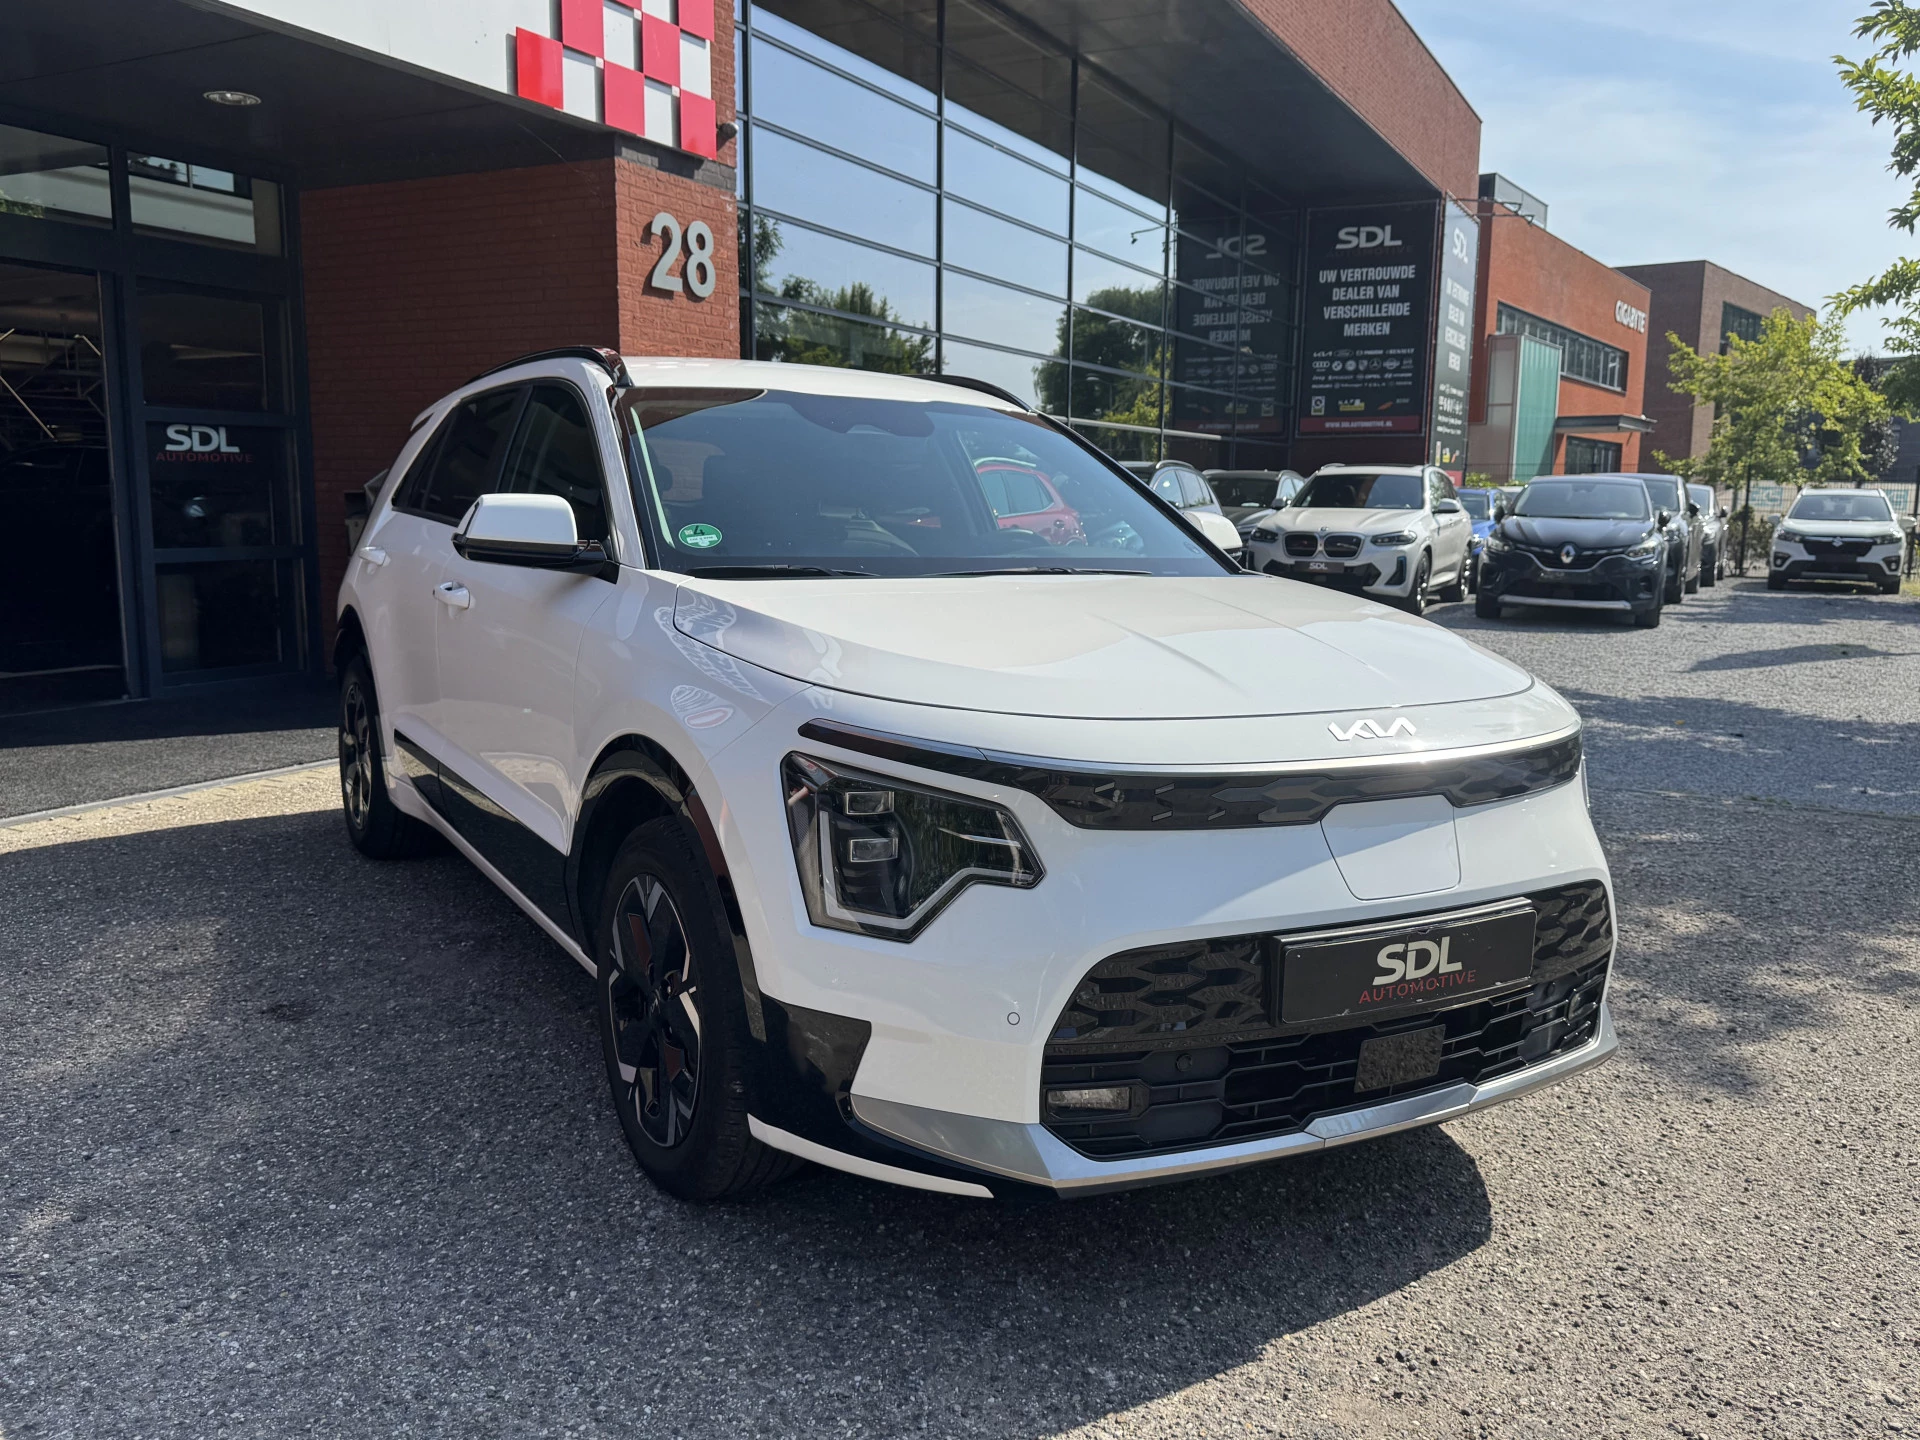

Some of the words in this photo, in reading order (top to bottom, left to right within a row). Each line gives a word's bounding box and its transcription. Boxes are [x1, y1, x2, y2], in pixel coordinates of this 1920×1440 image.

[1336, 225, 1402, 249] SDL
[651, 212, 716, 298] 28
[1319, 270, 1338, 283] UW
[1340, 265, 1416, 282] VERTROUWDE
[1332, 286, 1374, 301] DEALER
[1377, 285, 1400, 299] VAN
[1323, 302, 1411, 320] VERSCHILLENDE
[1344, 322, 1391, 337] MERKEN
[165, 424, 240, 453] SDL
[156, 452, 253, 463] AUTOMOTIVE
[1309, 562, 1328, 570] SDL
[1327, 716, 1416, 741] KIA
[1372, 936, 1463, 986] SDL
[1359, 969, 1477, 1004] AUTOMOTIVE
